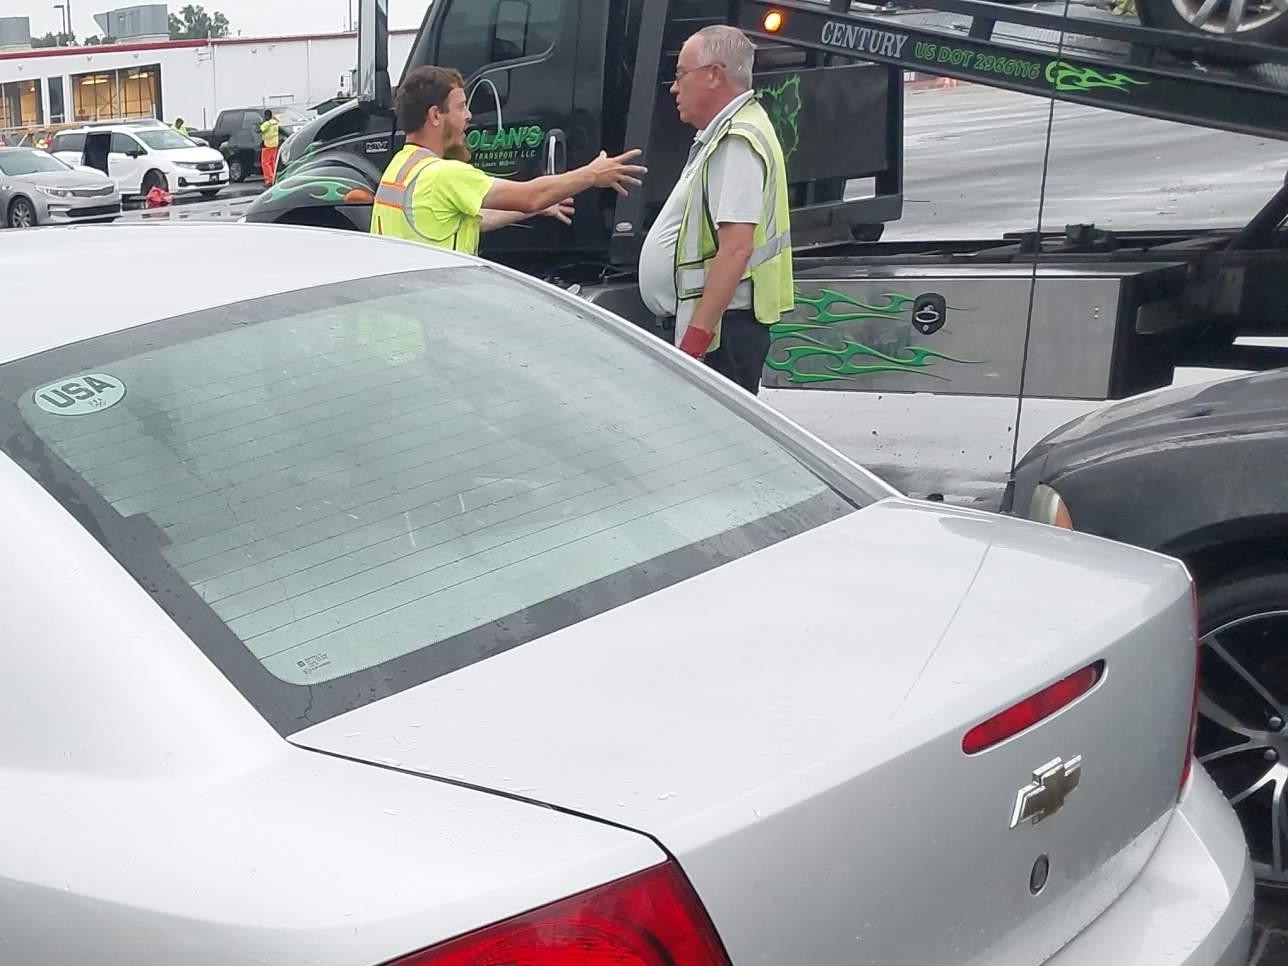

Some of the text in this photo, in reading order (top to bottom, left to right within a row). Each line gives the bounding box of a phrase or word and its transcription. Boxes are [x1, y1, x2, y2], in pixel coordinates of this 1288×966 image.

[821, 21, 909, 58] CENTURY
[914, 41, 1041, 79] US DOT 2966116
[465, 125, 544, 151] OLAN'S
[474, 150, 519, 160] TRANSPORT
[39, 376, 117, 408] USA
